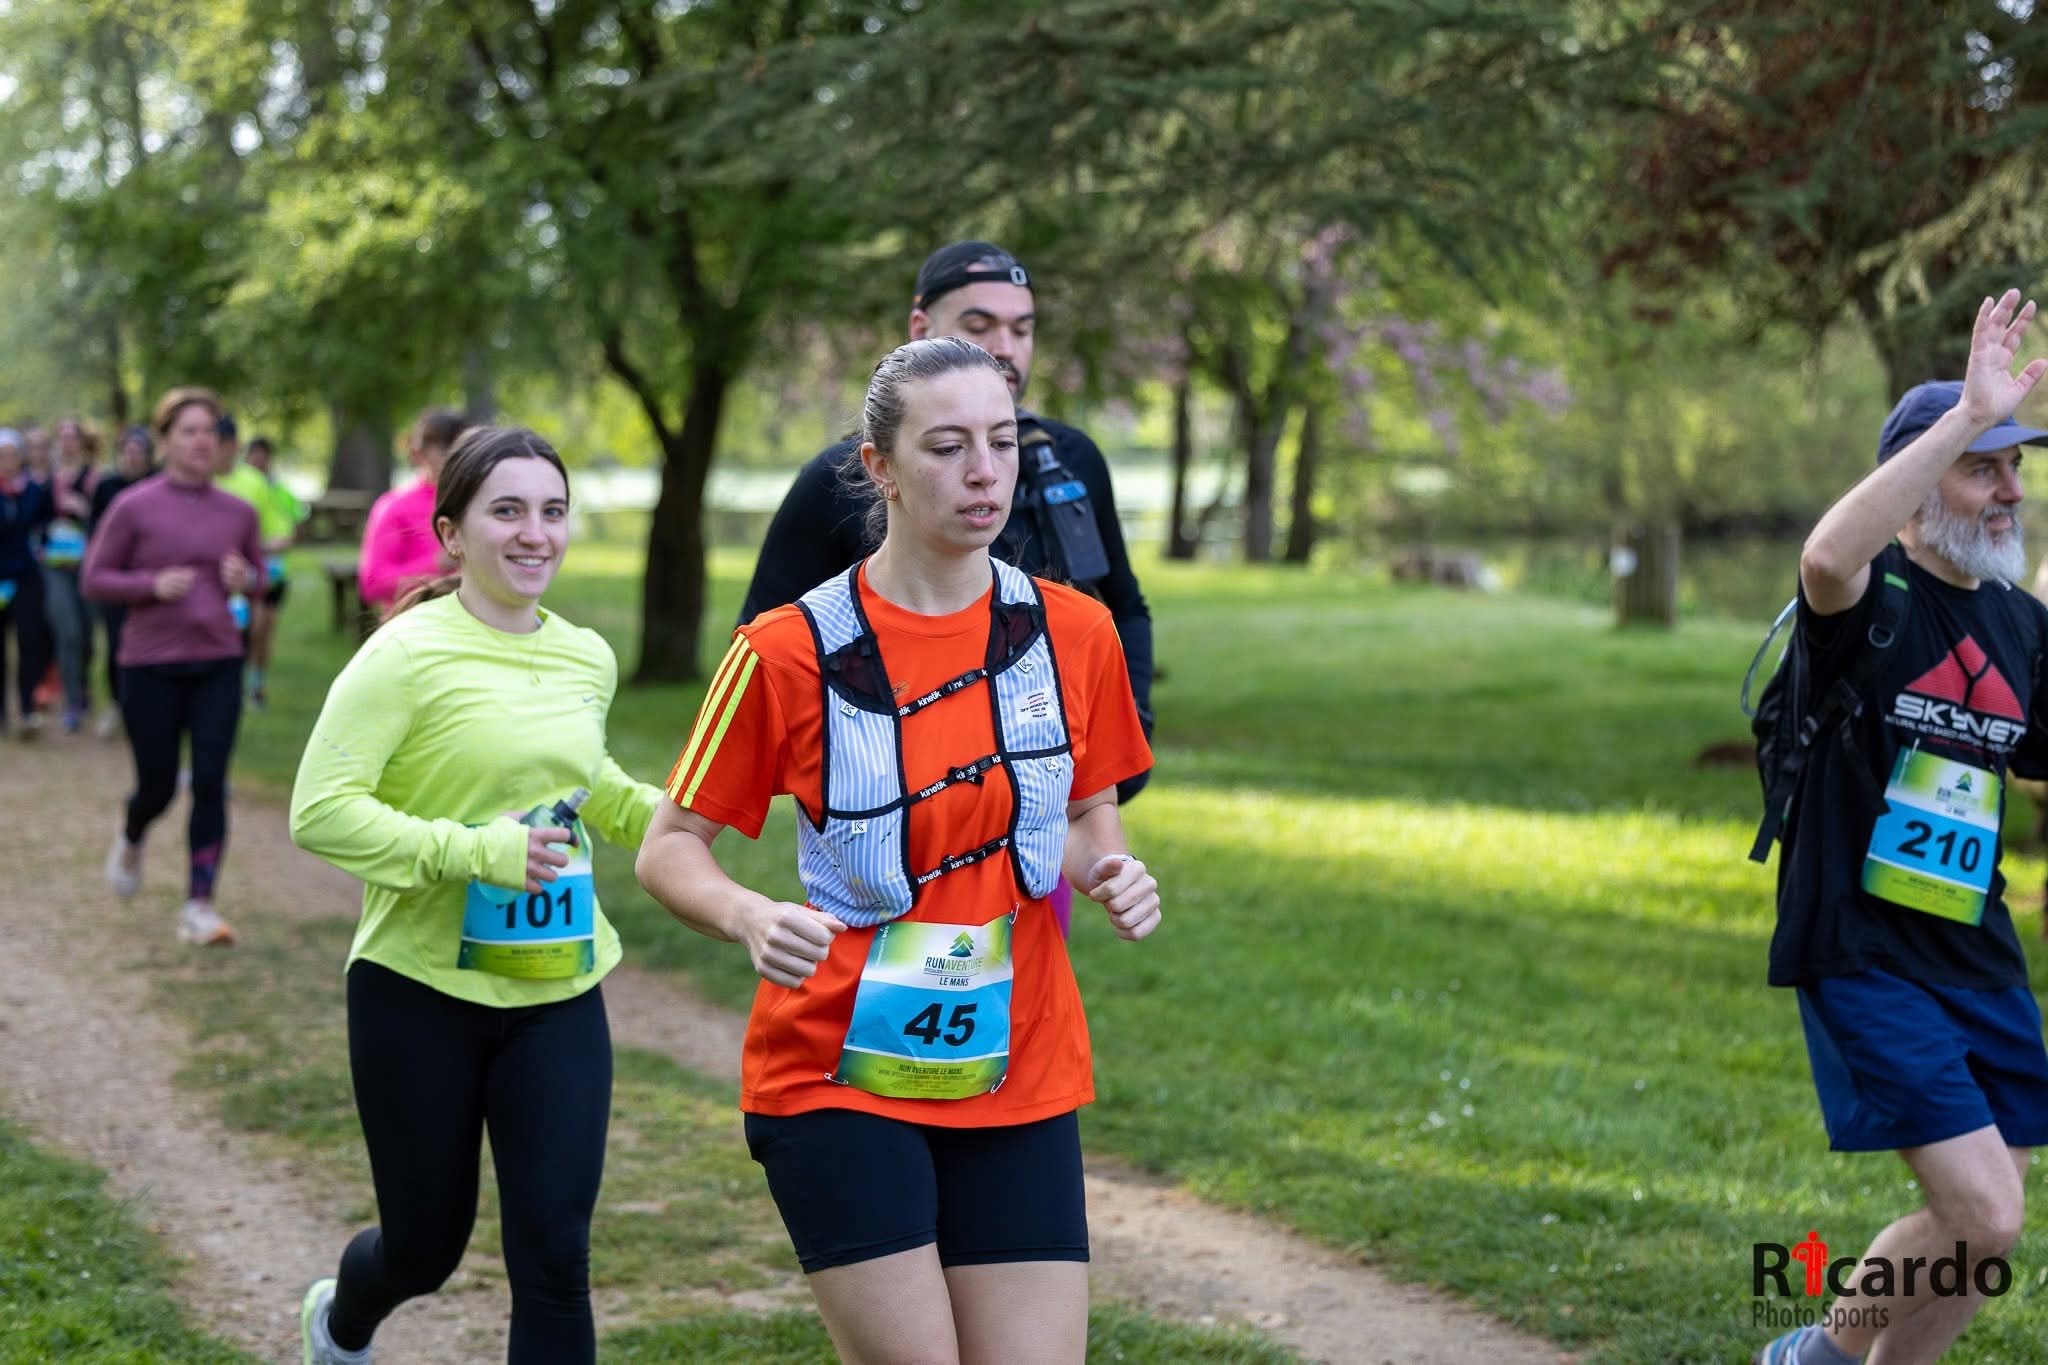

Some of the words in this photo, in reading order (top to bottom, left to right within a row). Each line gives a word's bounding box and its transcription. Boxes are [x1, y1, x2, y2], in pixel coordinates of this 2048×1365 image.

[917, 691, 941, 707] kinetik
[1893, 693, 2027, 745] SKYNET
[920, 781, 947, 798] kinetik
[1897, 820, 1981, 873] 210
[917, 869, 942, 885] kinetik
[496, 888, 573, 929] 101
[925, 956, 984, 971] RUNAVENTURE
[939, 976, 949, 986] LE
[949, 977, 969, 987] MANS
[904, 1002, 977, 1047] 45
